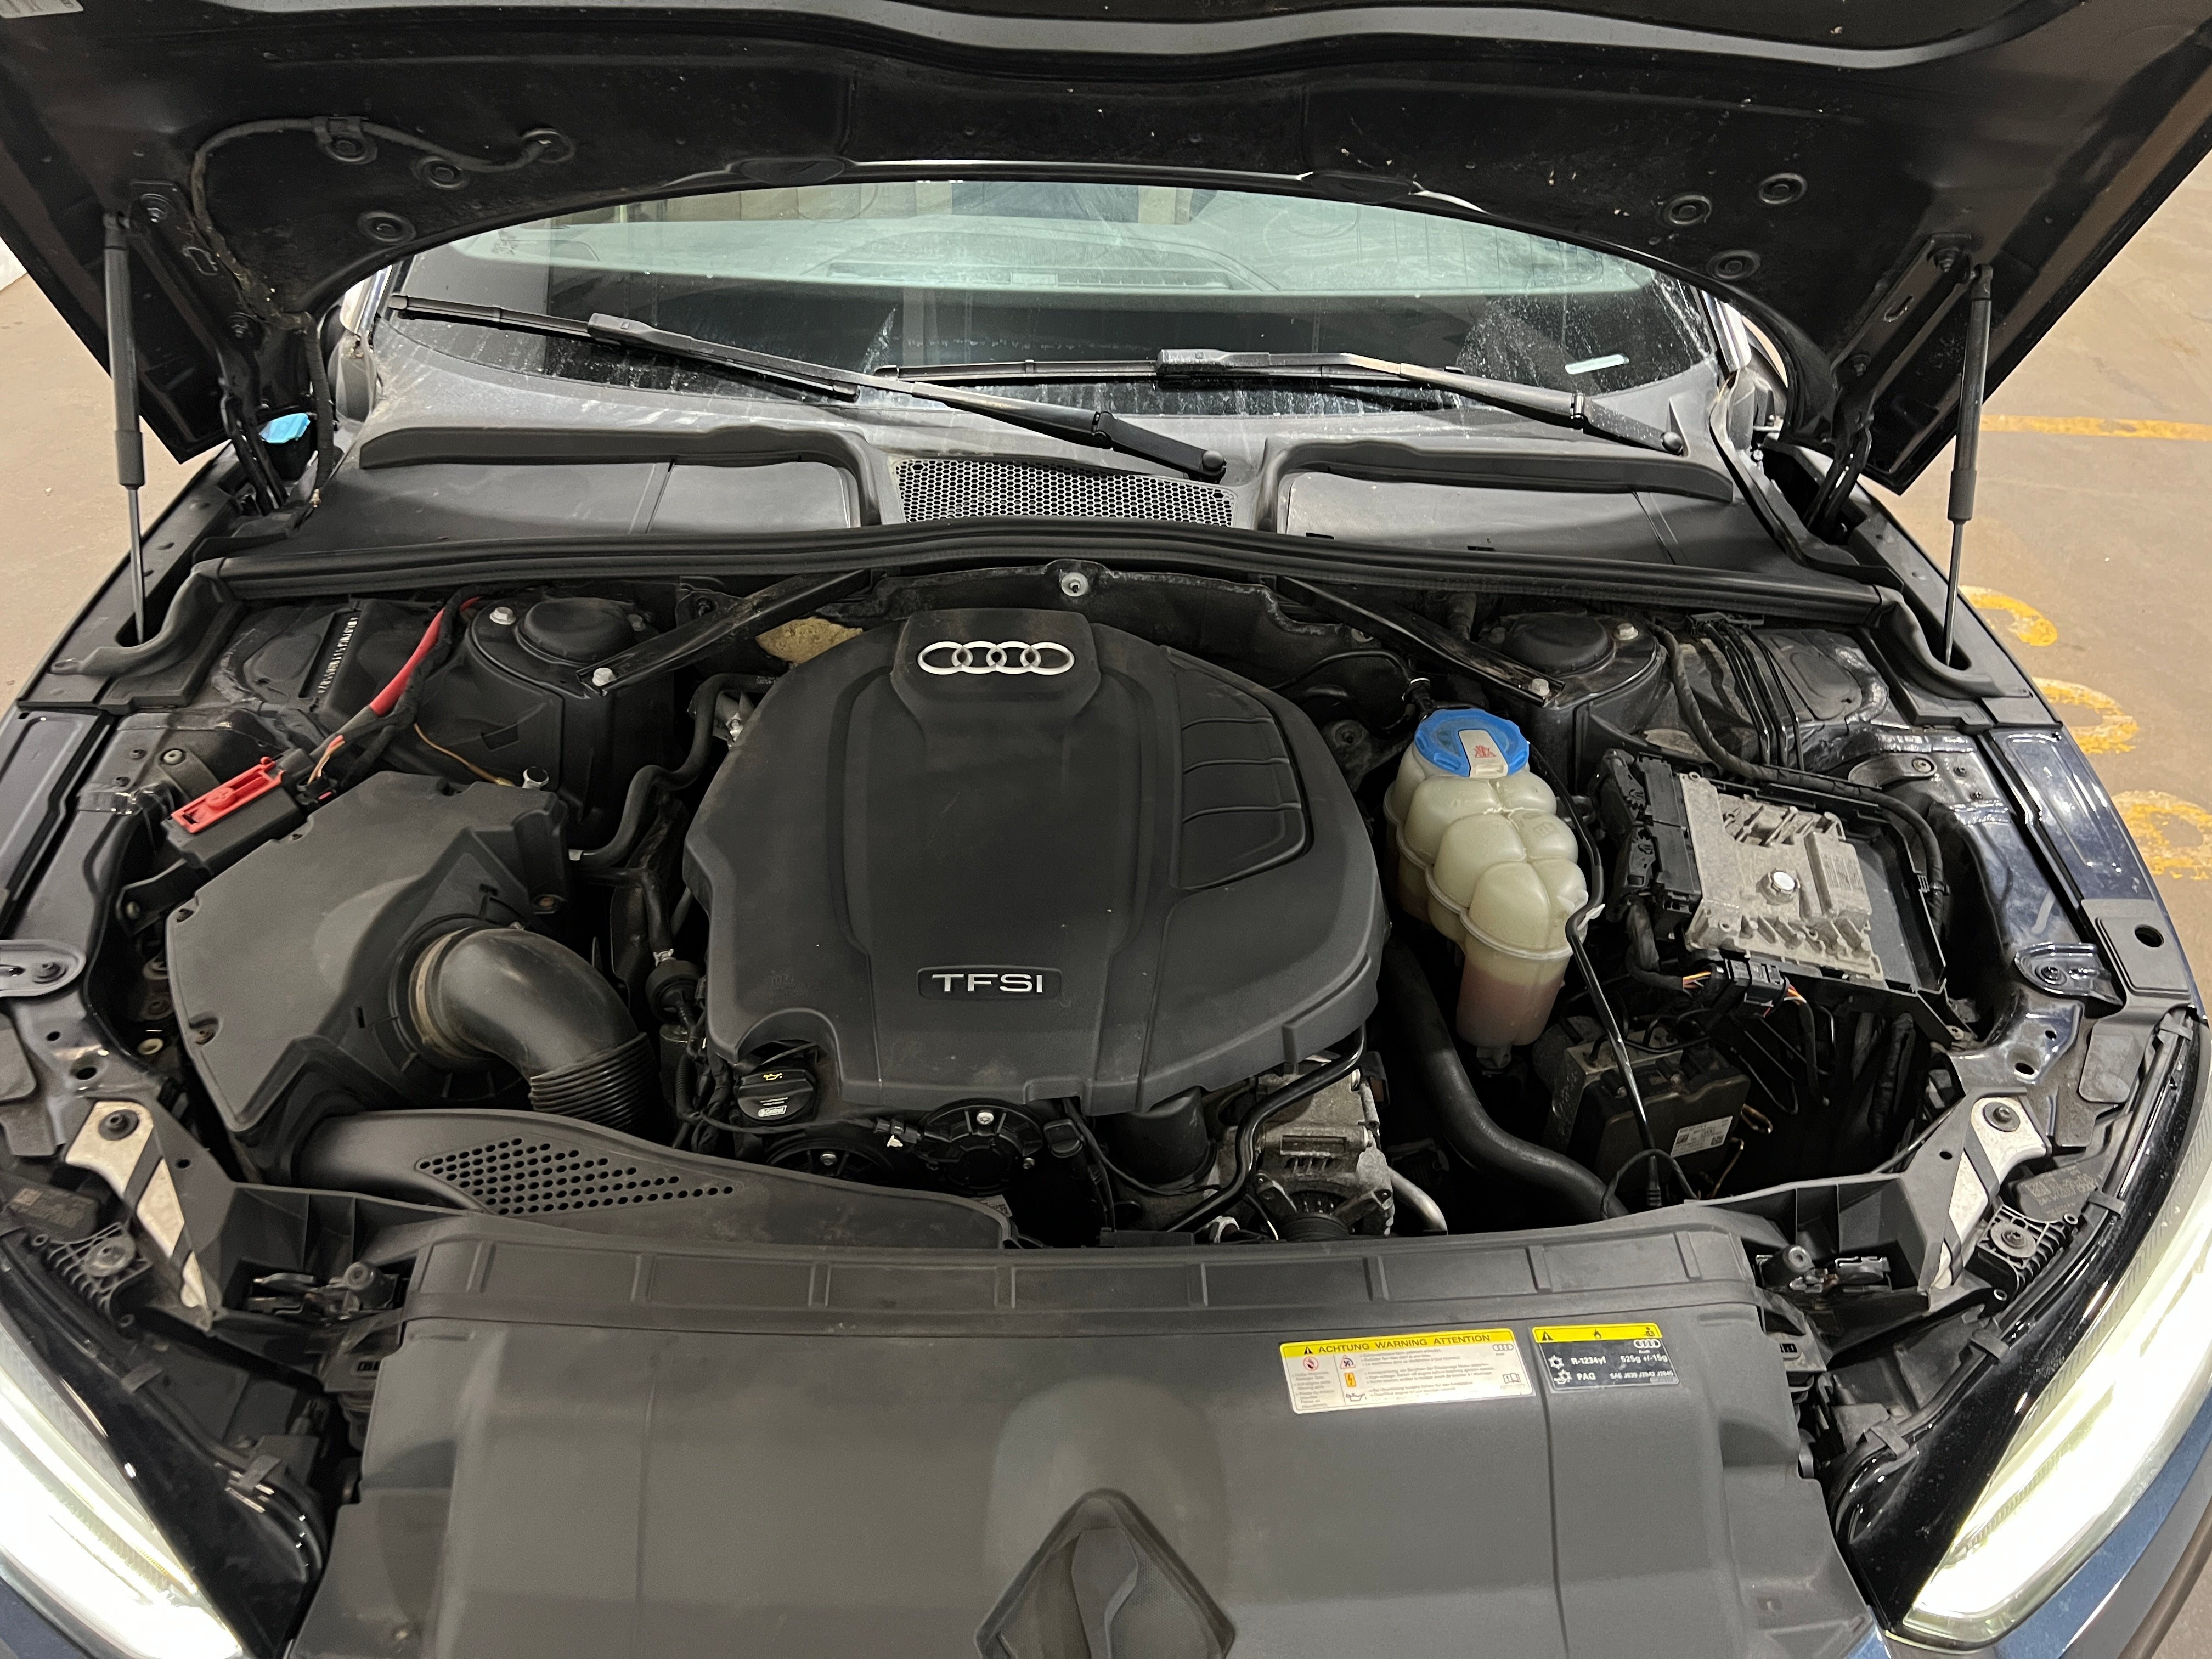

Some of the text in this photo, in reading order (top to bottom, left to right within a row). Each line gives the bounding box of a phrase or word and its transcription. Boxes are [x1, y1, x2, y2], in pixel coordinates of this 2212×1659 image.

[933, 974, 1042, 992] TFSI
[1318, 1334, 1491, 1353] ACHTUNG WARNING ATTENTION
[1577, 1372, 1596, 1381] PAG
